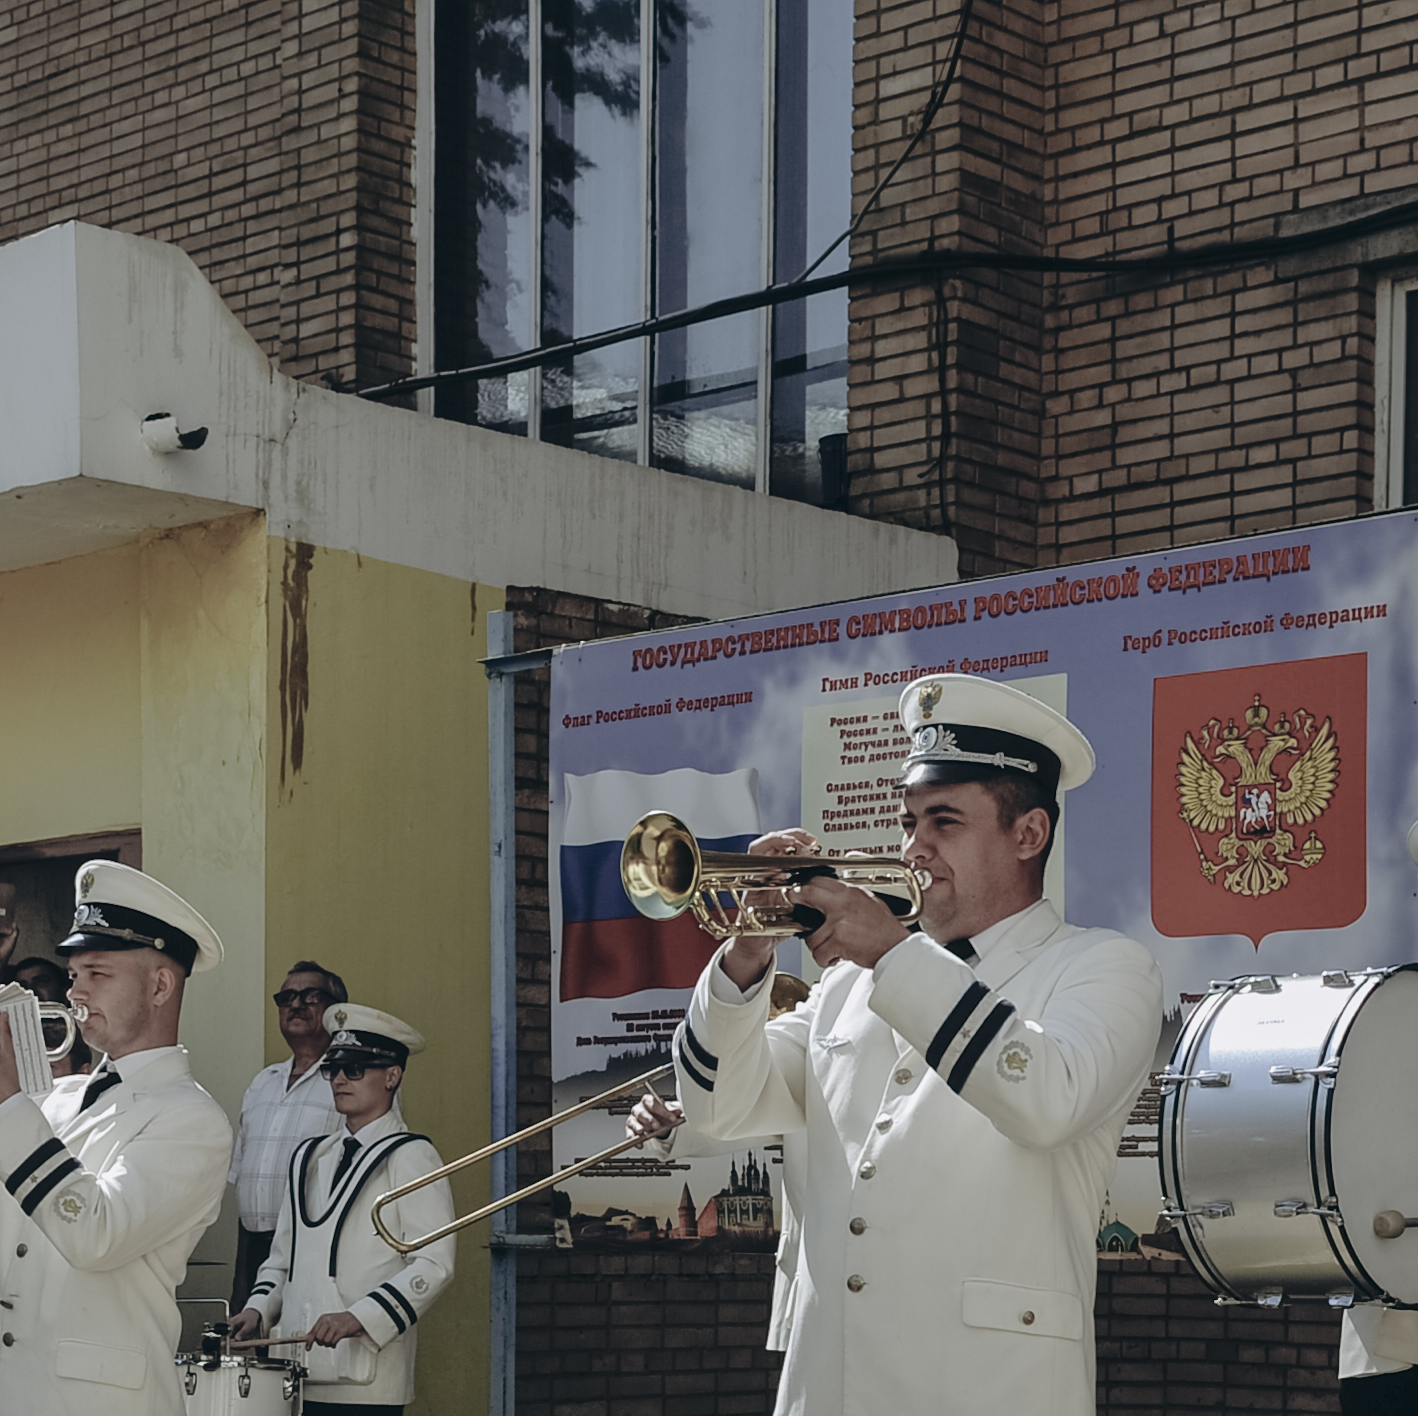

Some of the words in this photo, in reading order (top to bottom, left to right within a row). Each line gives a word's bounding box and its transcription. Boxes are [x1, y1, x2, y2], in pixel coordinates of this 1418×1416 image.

[632, 618, 841, 672] ГОСУДАРСТВЕННЫЕ
[846, 597, 967, 640] СИМВОЛЫ
[974, 566, 1140, 622] РОССИЙСКОЙ
[1147, 544, 1312, 594] ФЕДЕРАЦИИ
[1122, 629, 1162, 653] Герб
[1167, 615, 1275, 647] Российской
[1280, 603, 1388, 631] Федерации
[821, 676, 859, 693] Гимн
[959, 650, 1049, 675] Федерации
[562, 713, 593, 729] Флаг
[595, 699, 672, 725] Российской
[676, 691, 753, 713] Федерации
[829, 715, 868, 727] Россия
[839, 727, 878, 739] Россия
[843, 739, 889, 752] Могучая
[826, 781, 874, 794] Славься,
[837, 791, 888, 807] Братских
[822, 806, 876, 821] Предками
[823, 820, 870, 833] Славься,
